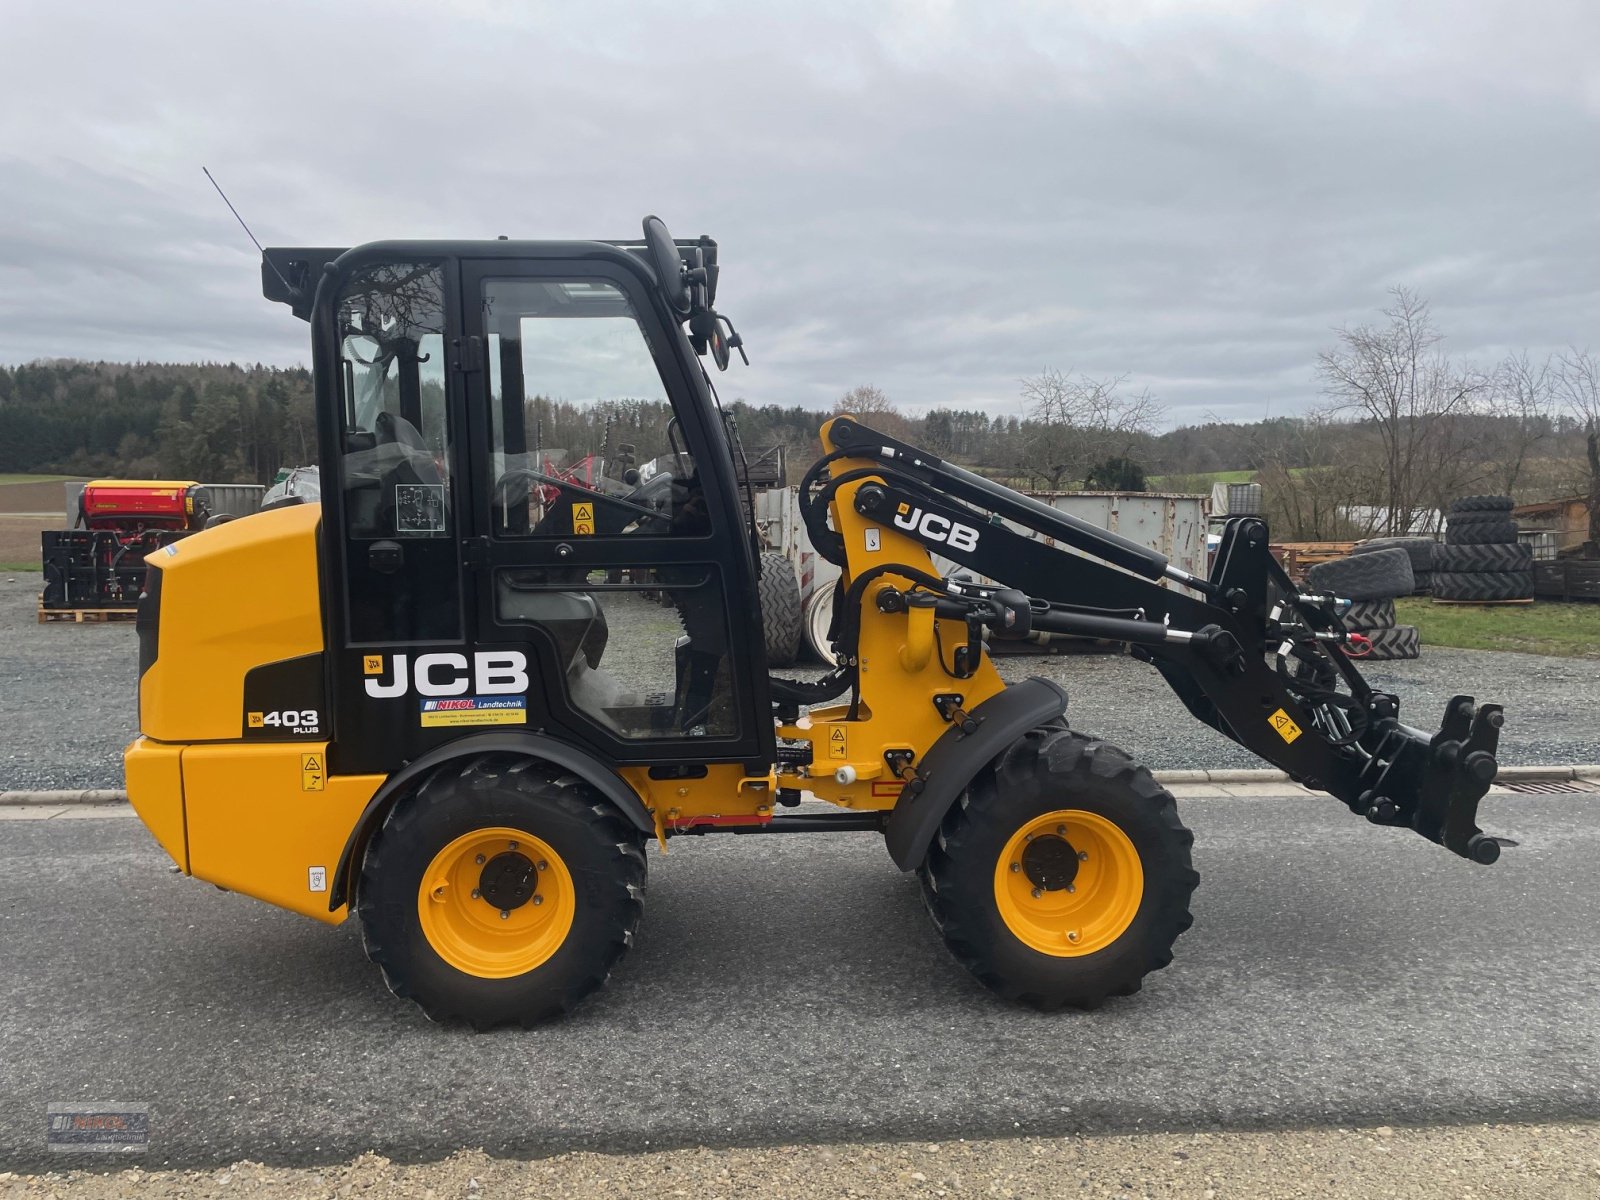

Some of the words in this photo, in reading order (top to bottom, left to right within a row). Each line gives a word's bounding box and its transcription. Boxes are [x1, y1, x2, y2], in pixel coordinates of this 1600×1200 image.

[894, 507, 980, 553] JCB
[364, 651, 530, 699] JCB
[264, 709, 319, 727] 403
[437, 699, 476, 710] NIKOL
[478, 701, 523, 709] Landtechnik
